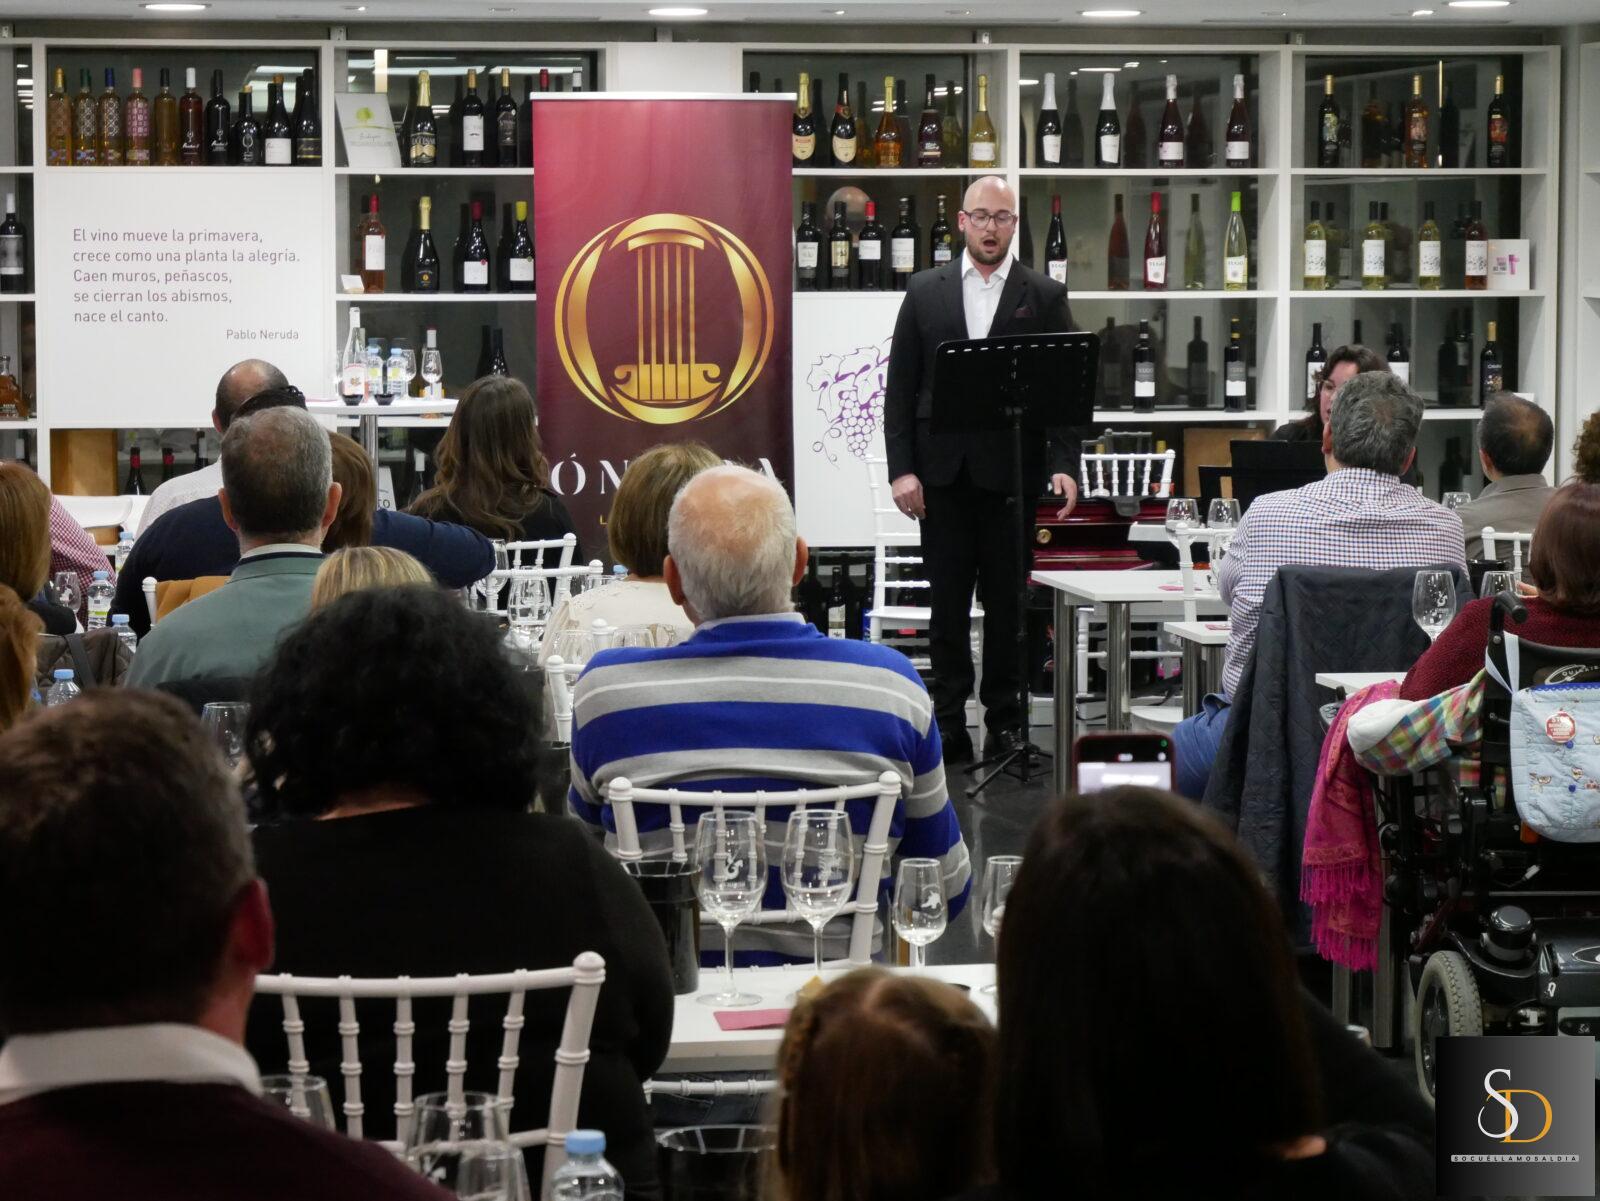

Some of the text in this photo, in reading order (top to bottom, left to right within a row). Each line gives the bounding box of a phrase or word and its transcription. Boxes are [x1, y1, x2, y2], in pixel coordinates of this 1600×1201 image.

[73, 228, 263, 246] El vino mueve la primavera,
[72, 251, 111, 263] crece
[114, 251, 152, 262] como
[156, 251, 181, 263] una
[185, 248, 228, 266] planta
[232, 248, 244, 262] la
[72, 268, 233, 287] Caen muros, peñascos,
[73, 288, 233, 306] se cierran los abismos,
[73, 309, 169, 324] nace el canto.
[226, 328, 299, 341] Pablo Neruda
